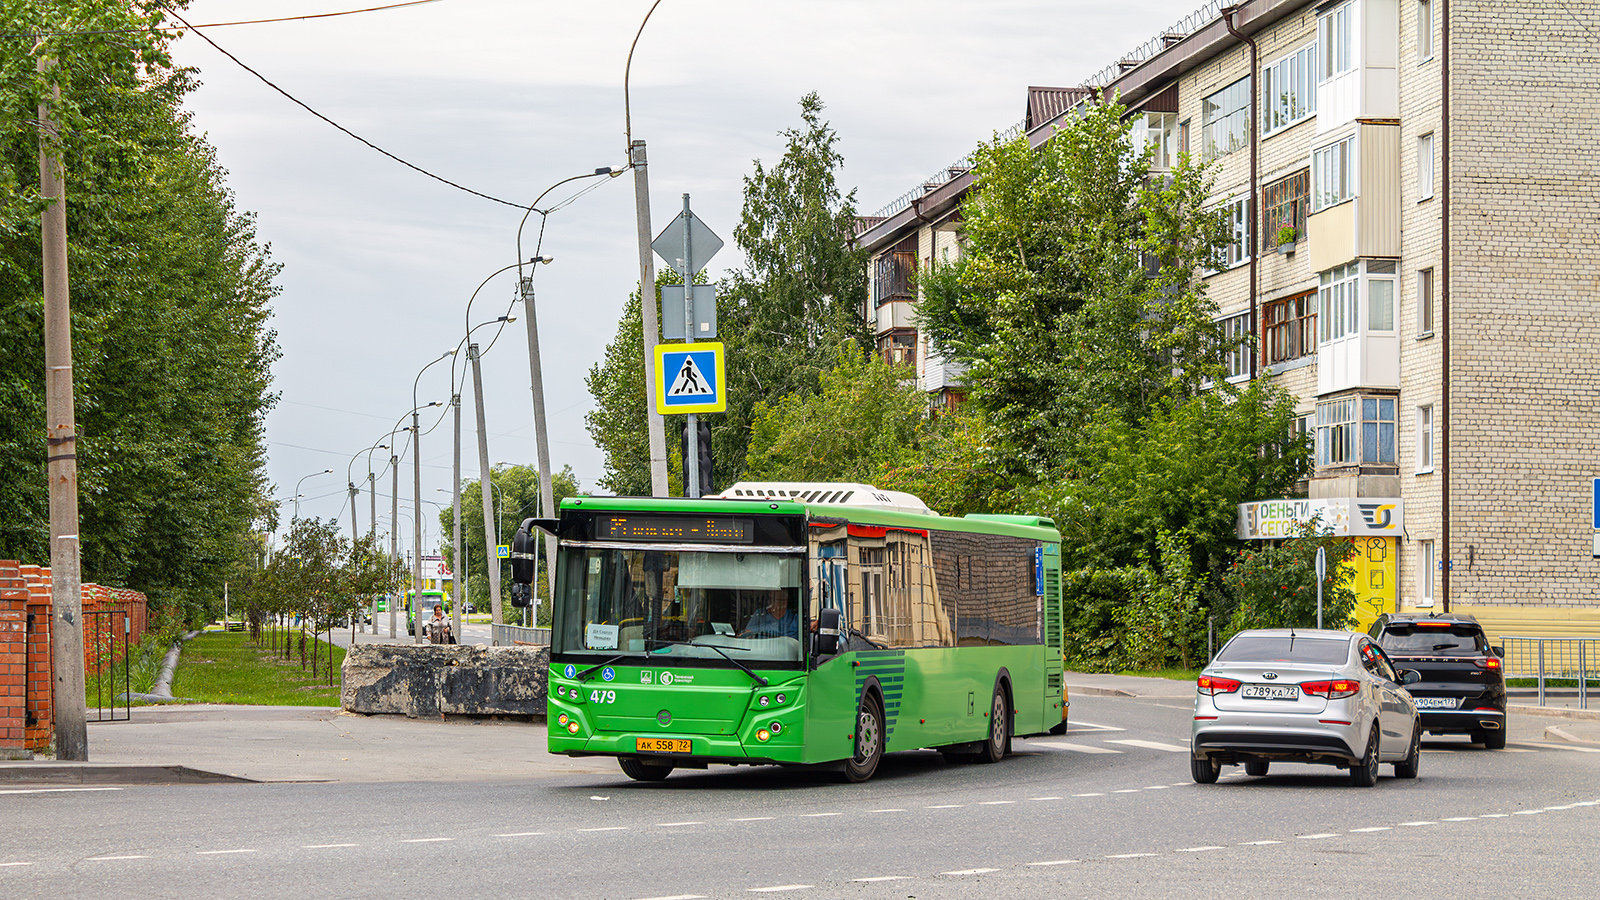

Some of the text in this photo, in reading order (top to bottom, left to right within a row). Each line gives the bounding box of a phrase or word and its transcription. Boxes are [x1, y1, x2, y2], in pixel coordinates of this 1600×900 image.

[1285, 687, 1296, 696] 72
[590, 690, 616, 704] 479
[641, 742, 652, 750] АК
[656, 741, 674, 750] 558
